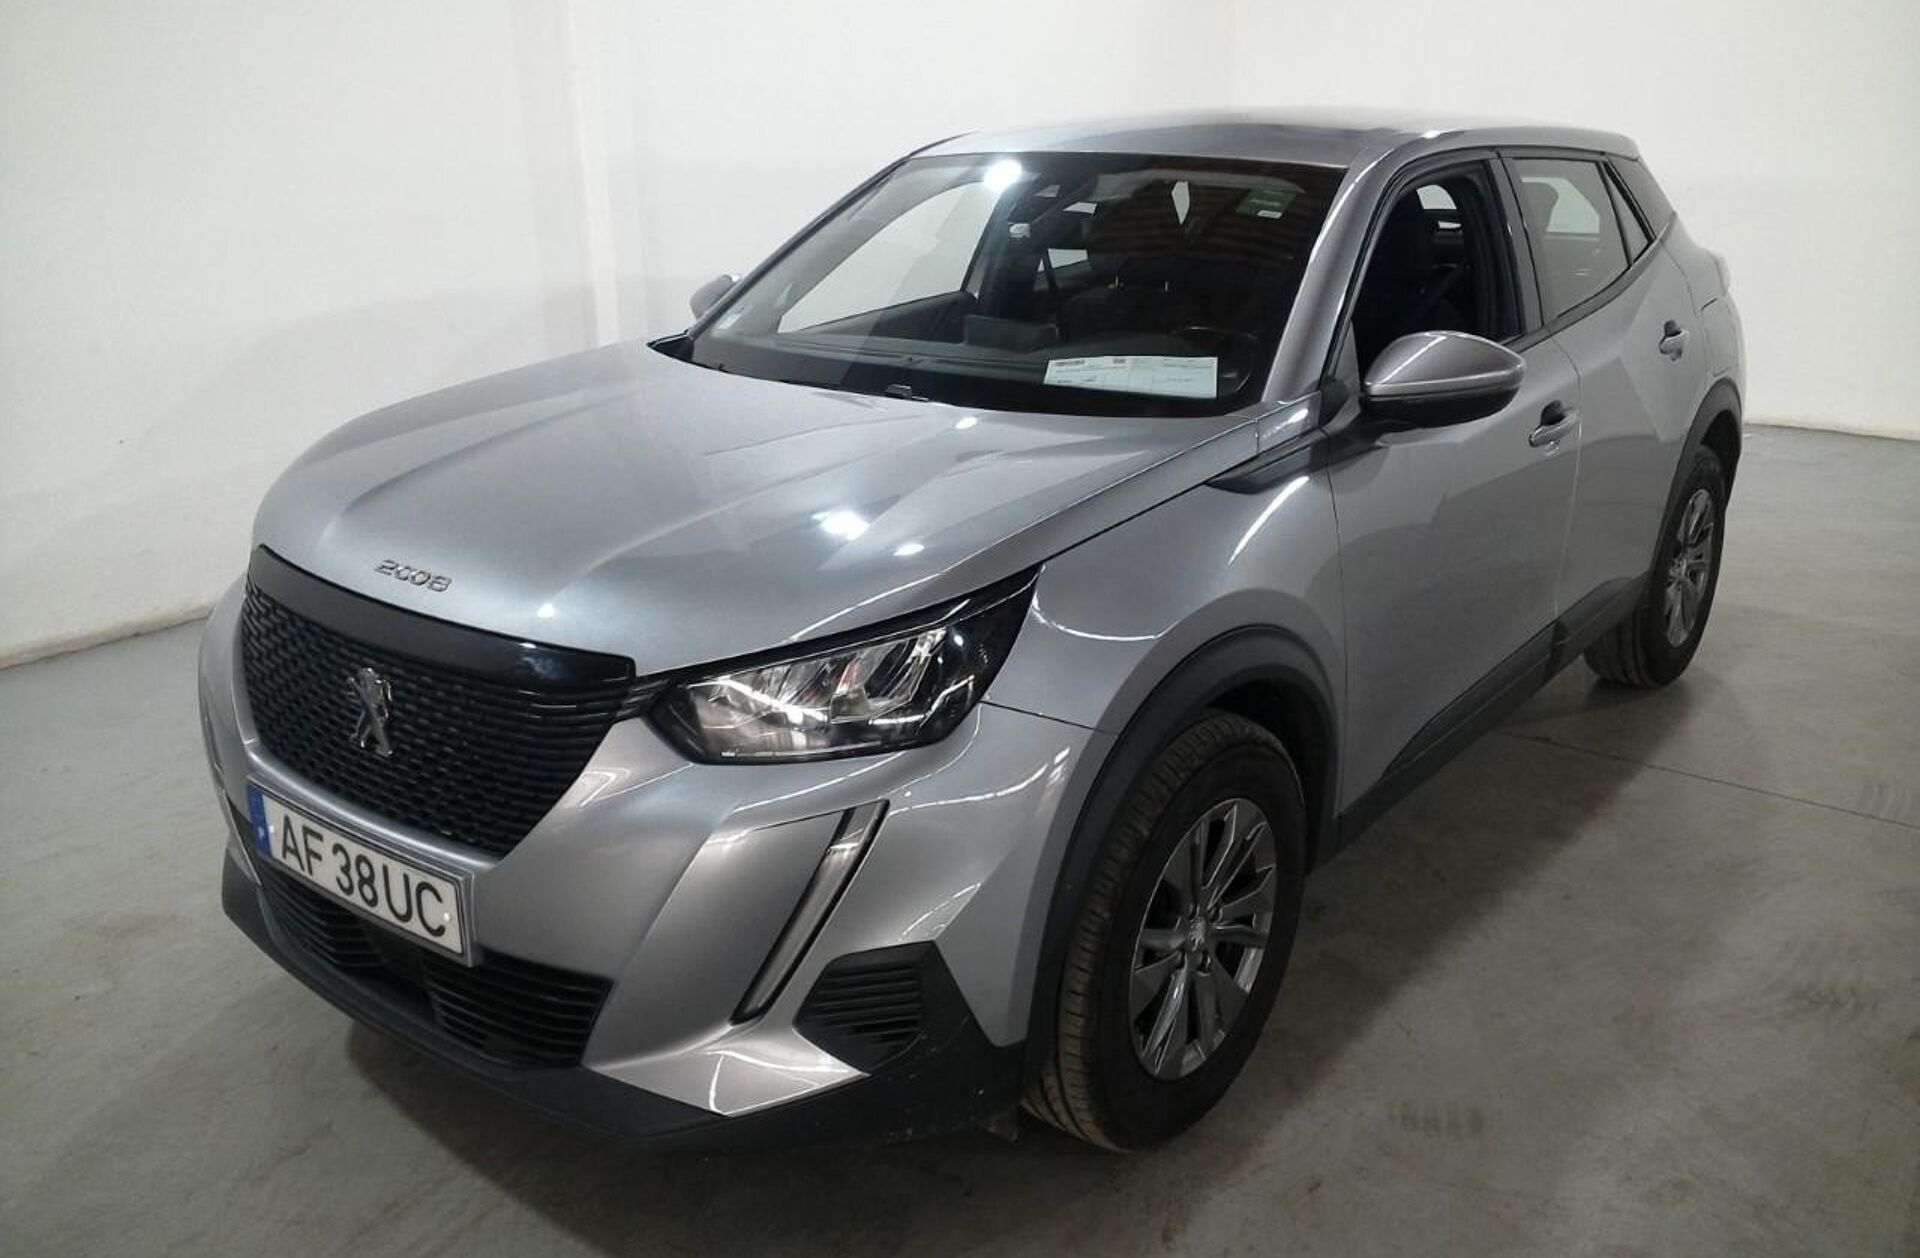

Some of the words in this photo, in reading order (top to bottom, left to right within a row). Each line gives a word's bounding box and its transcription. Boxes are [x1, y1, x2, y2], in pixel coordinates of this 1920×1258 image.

[374, 559, 453, 592] 2008
[281, 813, 325, 877] AF
[331, 842, 379, 908] 38
[382, 863, 447, 938] UC
